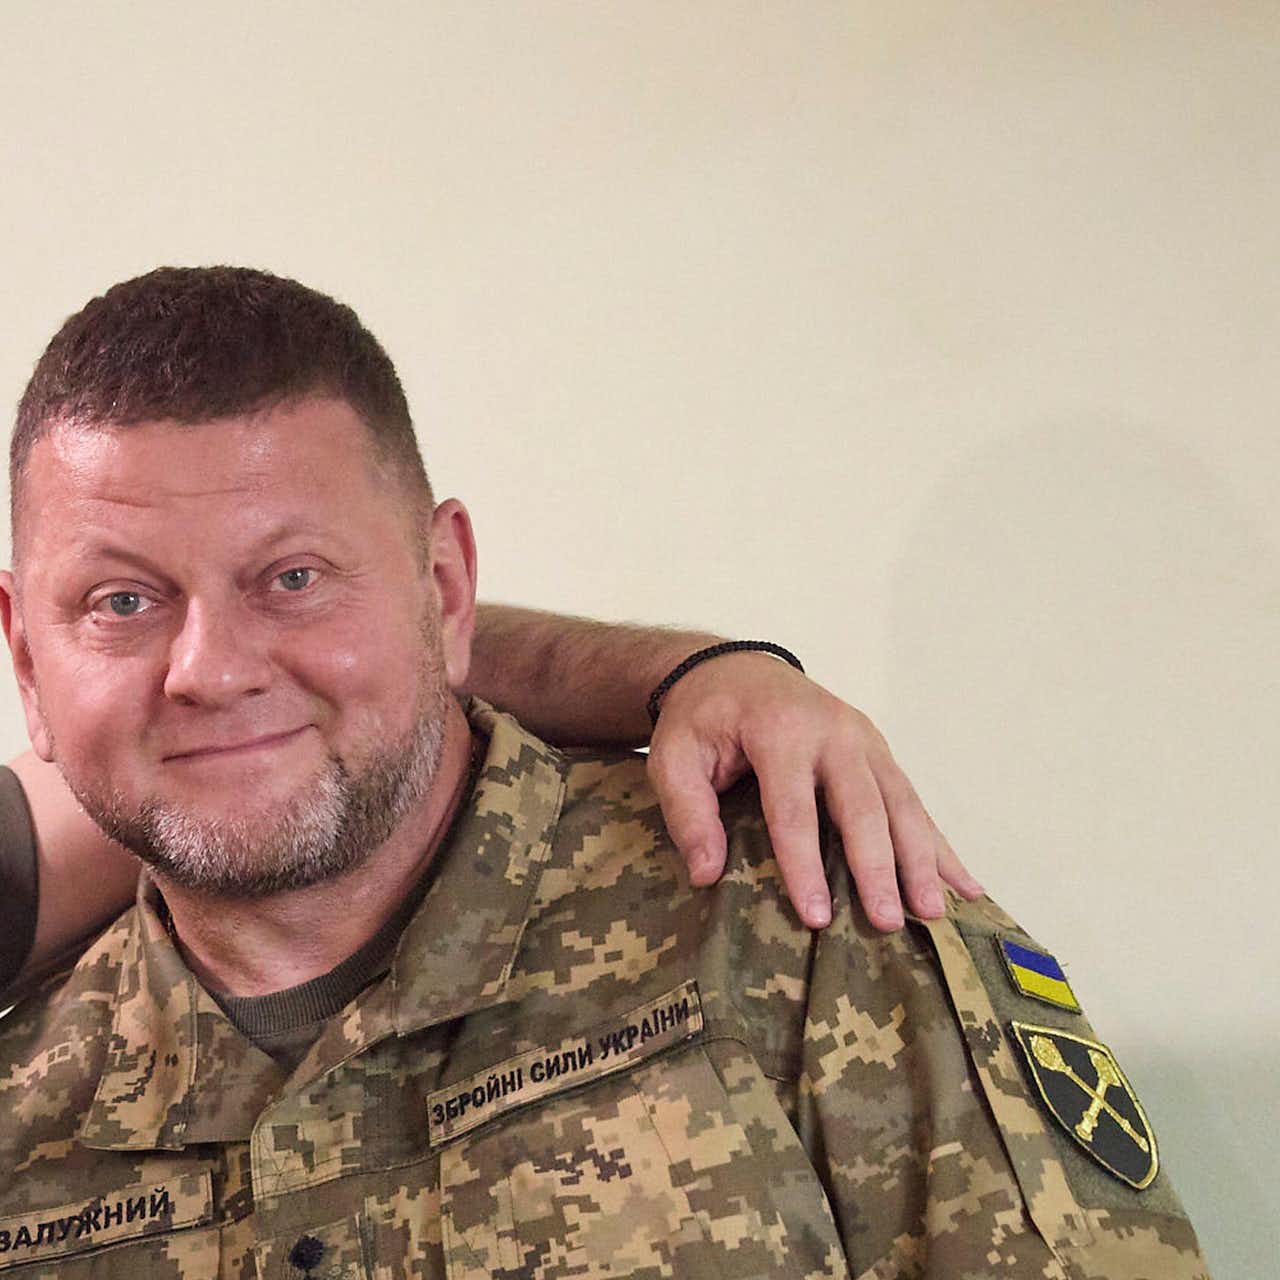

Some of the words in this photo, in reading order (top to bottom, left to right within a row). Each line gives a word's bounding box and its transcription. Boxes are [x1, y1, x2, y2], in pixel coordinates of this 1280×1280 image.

[431, 1068, 524, 1126] ЗБРОЙНІ
[529, 1043, 594, 1084] СИЛИ
[598, 997, 690, 1060] УКРАЇНИ
